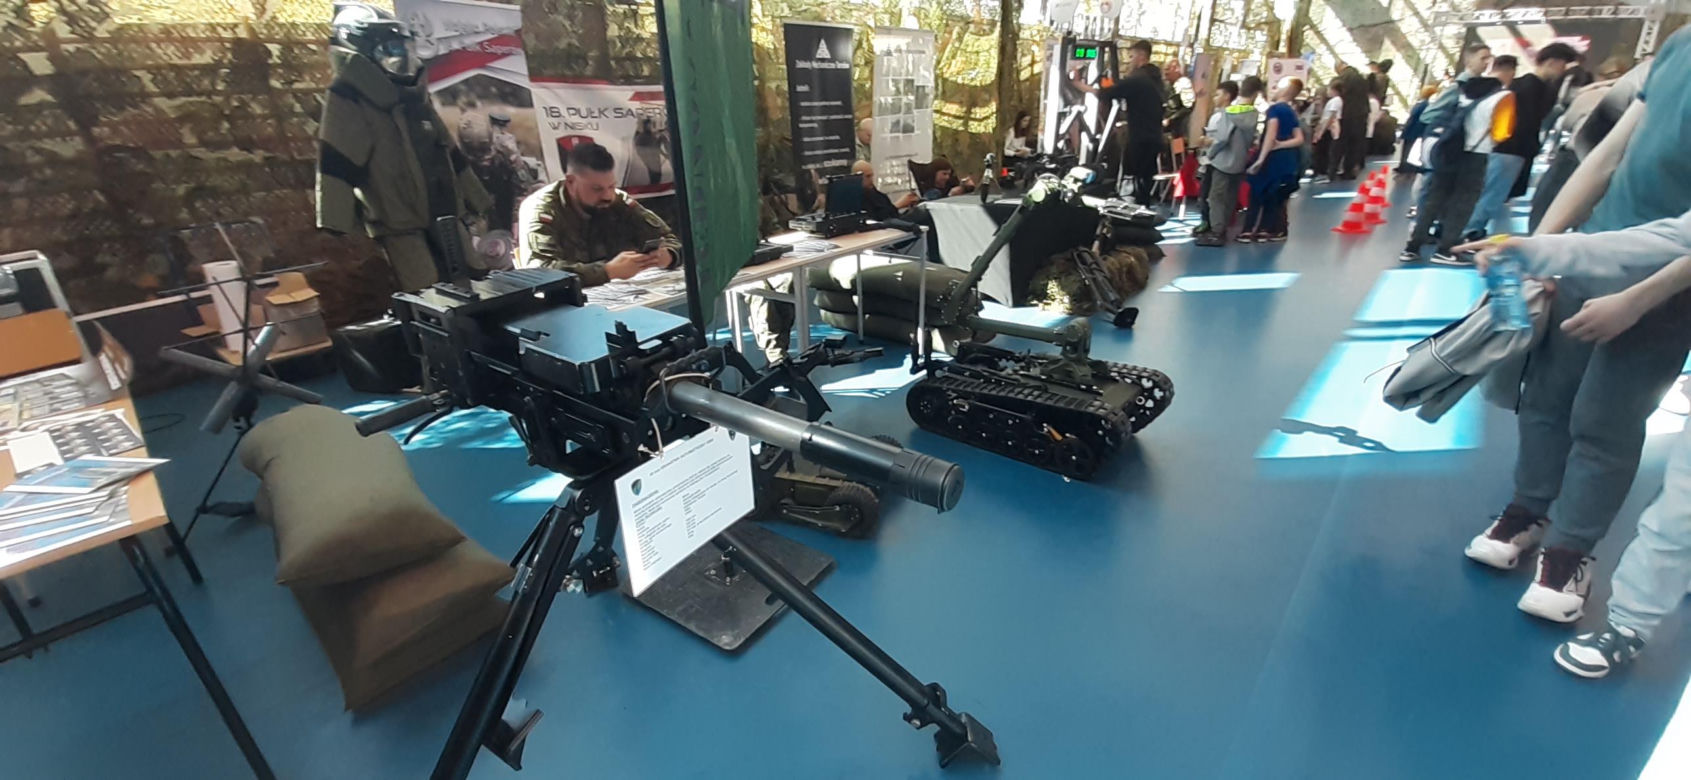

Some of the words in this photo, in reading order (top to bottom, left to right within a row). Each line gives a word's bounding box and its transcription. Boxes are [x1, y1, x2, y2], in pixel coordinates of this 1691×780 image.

[542, 106, 565, 119] 18.
[566, 106, 610, 119] PUŁK
[548, 121, 561, 130] W
[564, 121, 599, 131] NISKU
